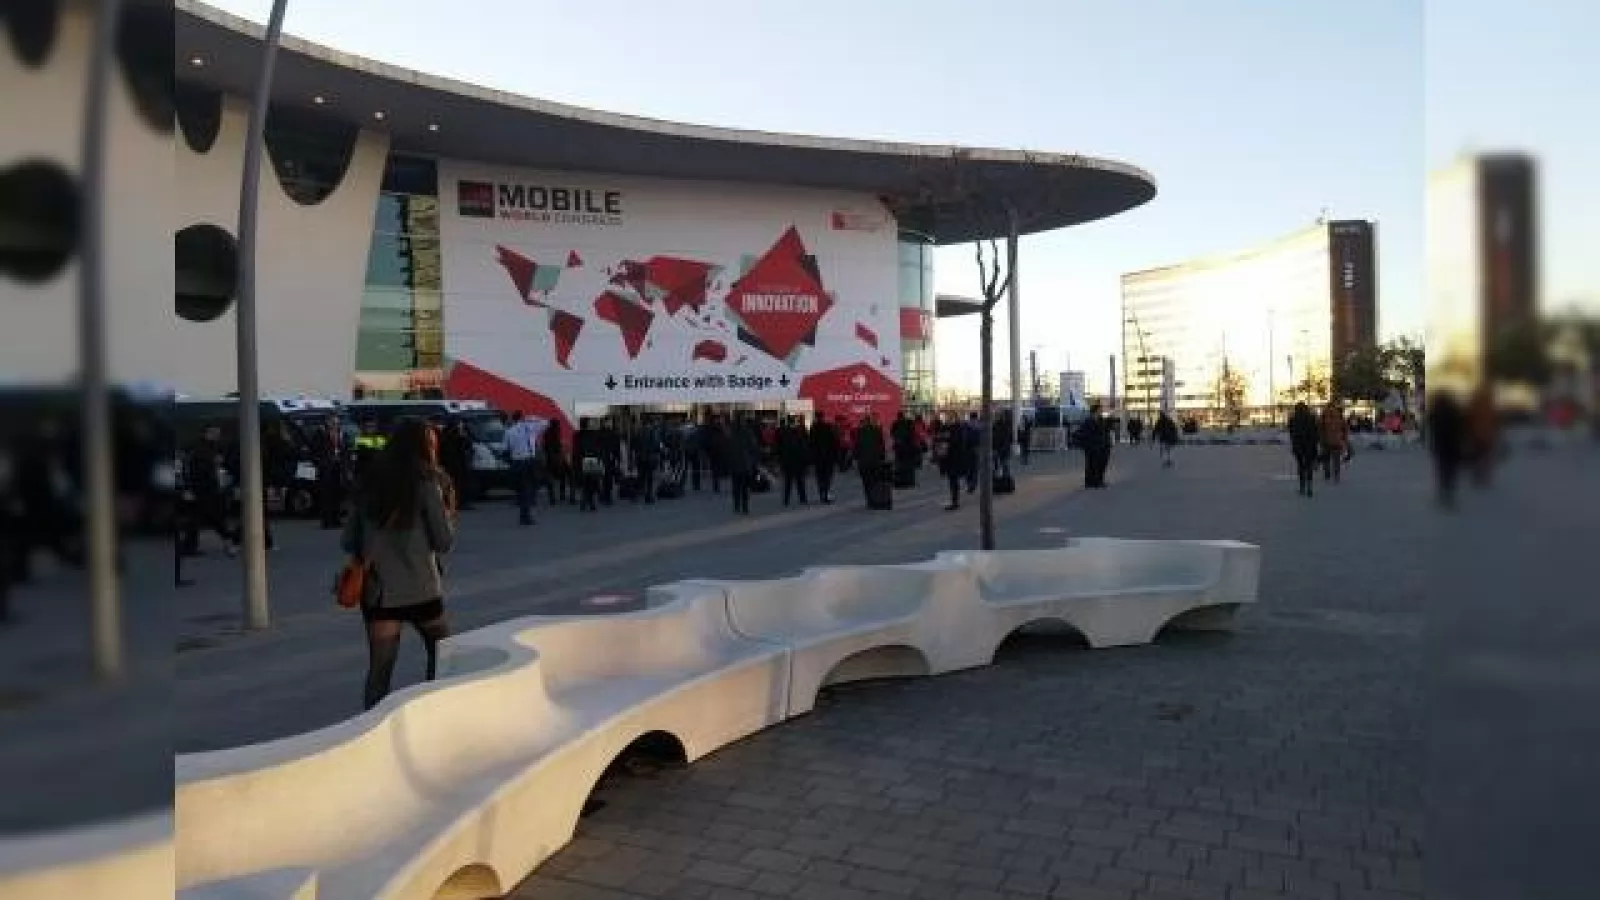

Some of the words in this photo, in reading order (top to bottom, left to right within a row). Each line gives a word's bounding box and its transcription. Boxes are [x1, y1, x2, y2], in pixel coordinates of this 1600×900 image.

[499, 184, 621, 214] MOBILE
[500, 209, 551, 221] WORLD
[741, 294, 818, 313] INNOVATION
[624, 374, 691, 389] Entrance
[694, 374, 726, 389] with
[727, 374, 773, 390] Badge
